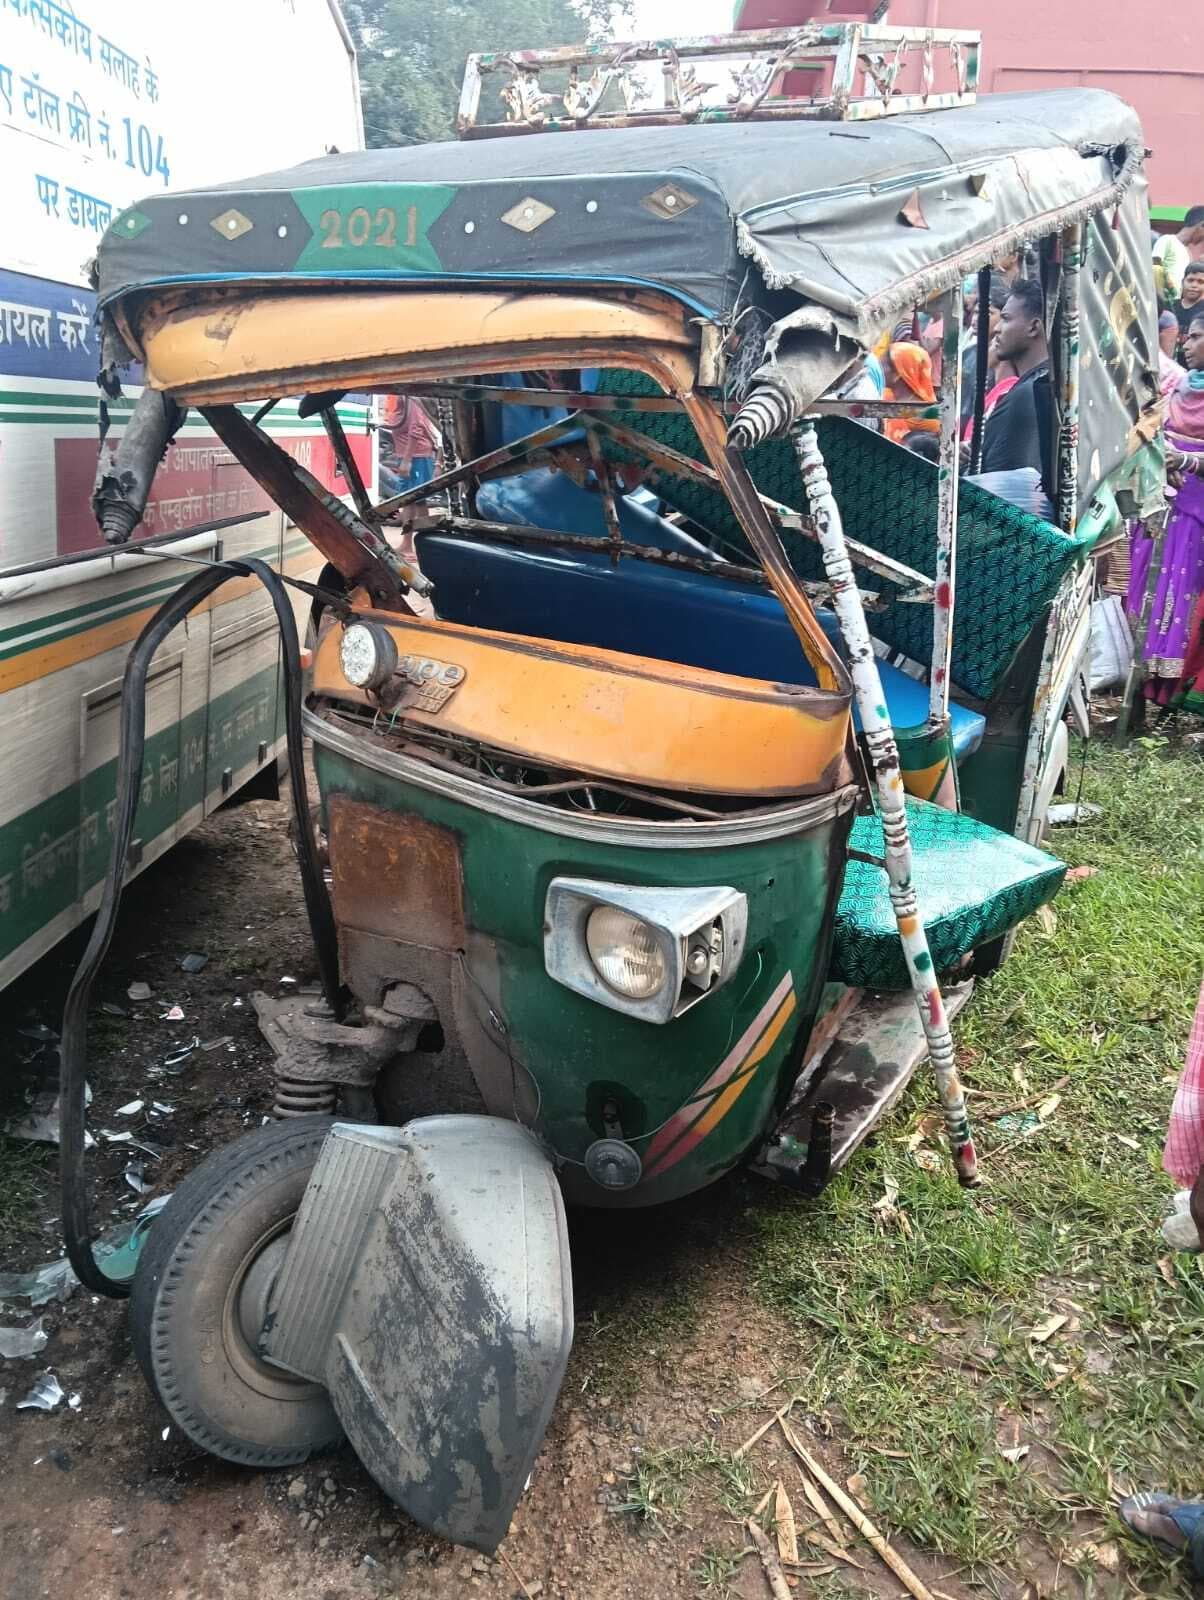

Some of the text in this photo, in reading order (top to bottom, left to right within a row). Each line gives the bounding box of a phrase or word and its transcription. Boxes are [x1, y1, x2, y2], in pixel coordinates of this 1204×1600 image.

[97, 34, 140, 100] सलाह
[144, 55, 159, 104] के
[20, 71, 60, 134] टॉल
[122, 117, 170, 186] 104
[35, 174, 112, 234] पर डायल
[320, 206, 418, 248] 2021
[57, 298, 91, 355] करें
